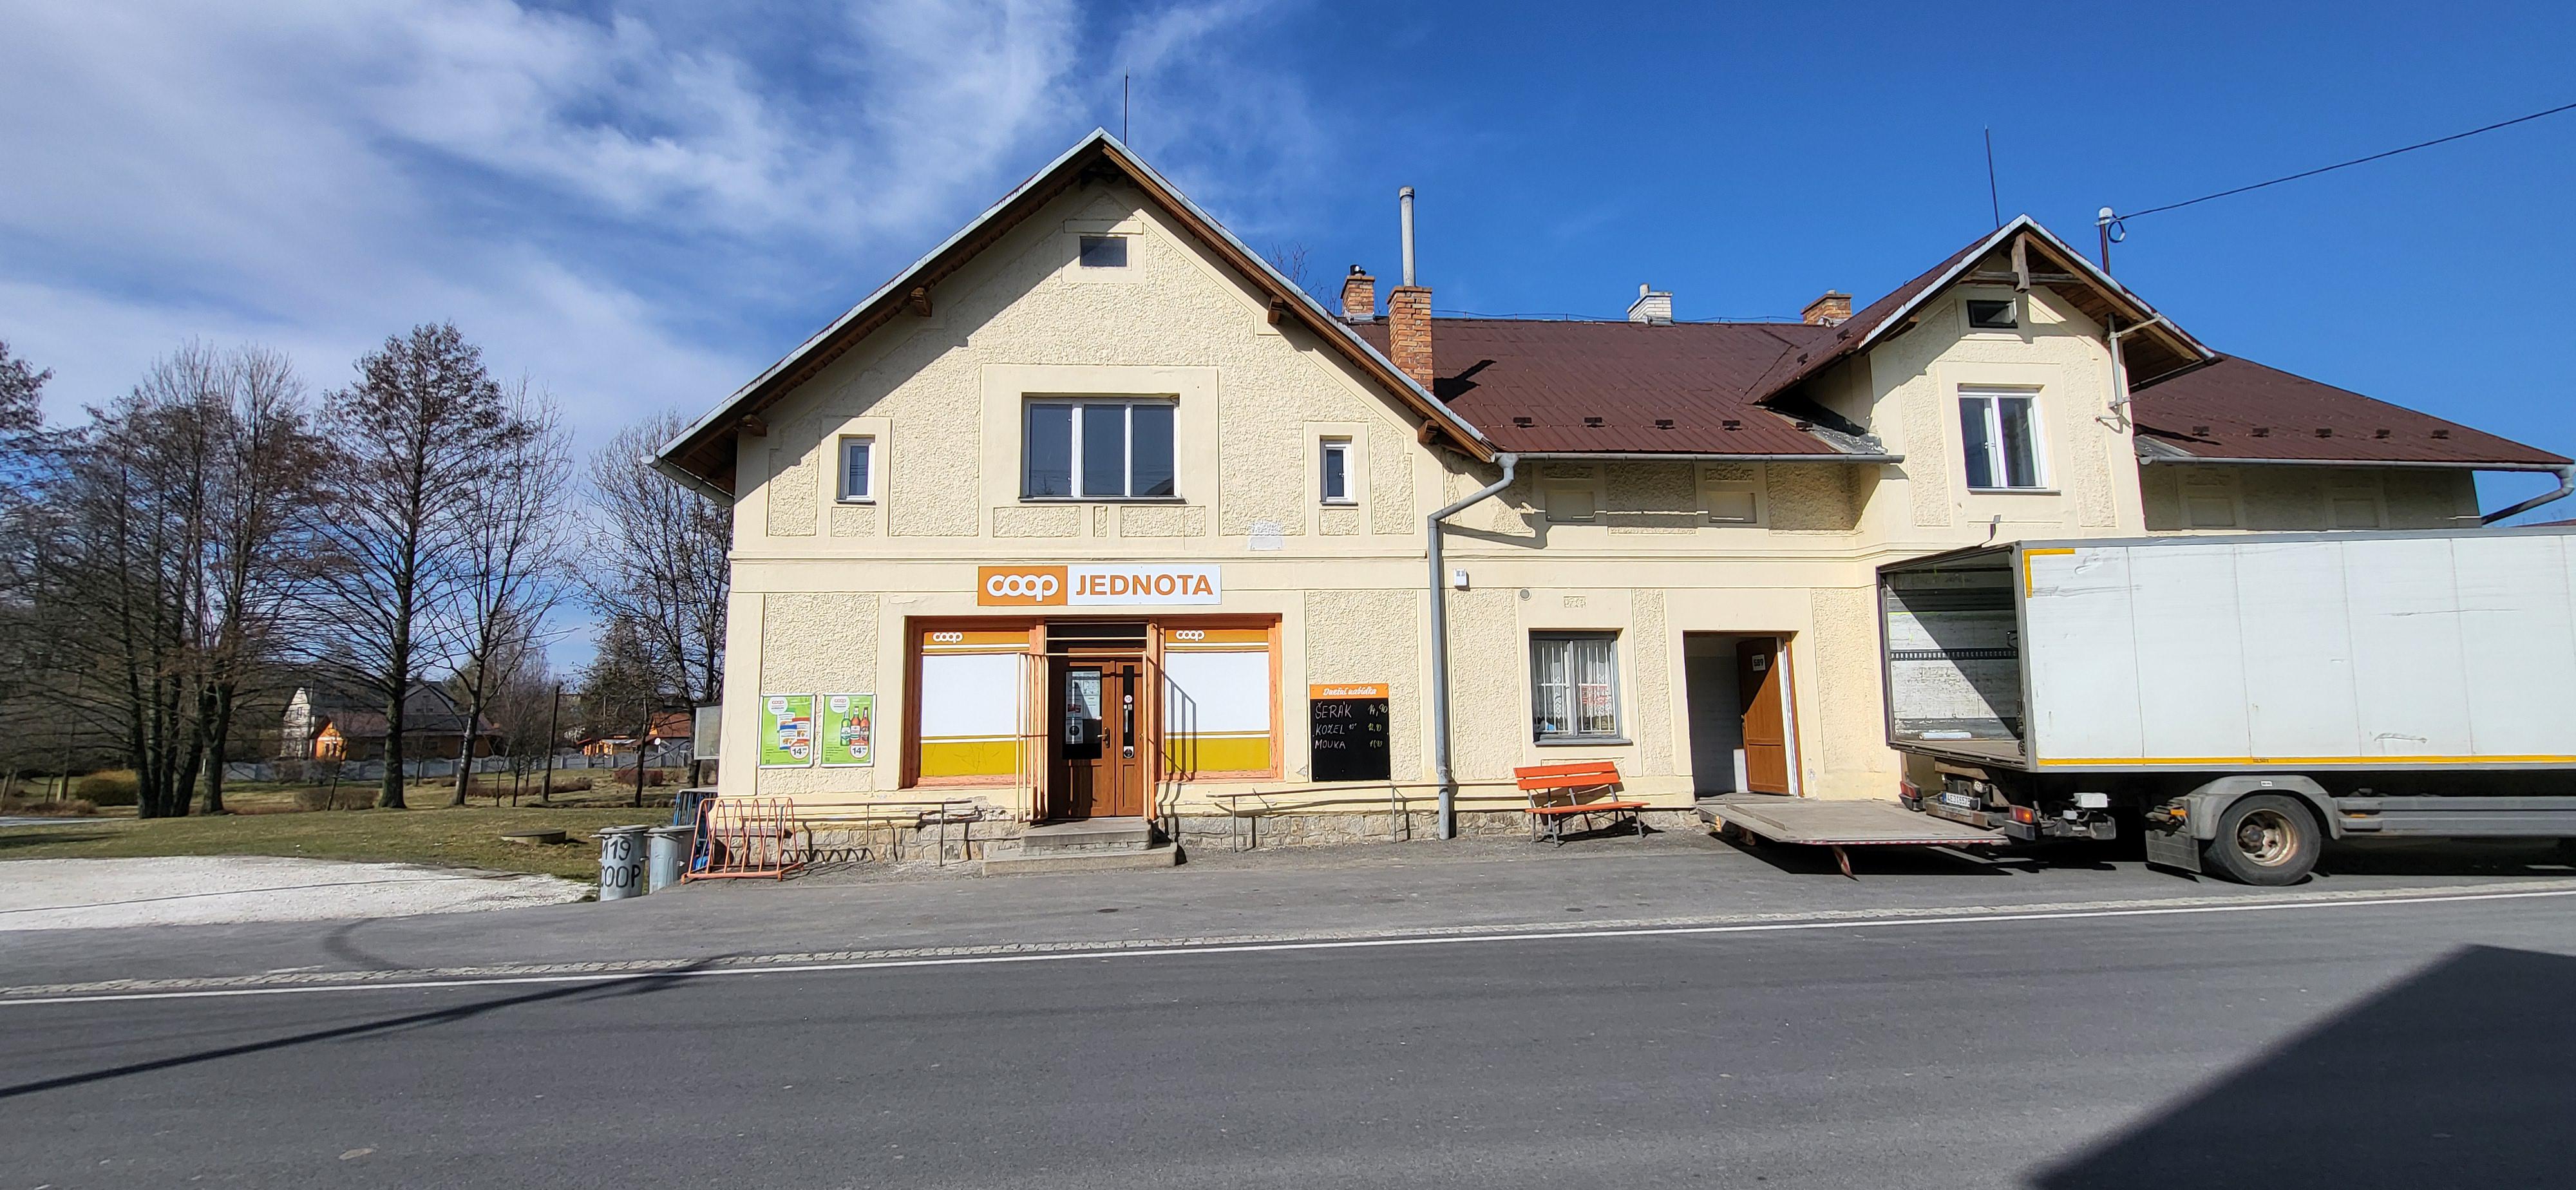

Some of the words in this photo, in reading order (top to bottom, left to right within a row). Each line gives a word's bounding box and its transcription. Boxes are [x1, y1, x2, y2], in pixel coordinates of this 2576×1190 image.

[986, 574, 1059, 602] coop
[1076, 574, 1214, 596] JEDNOTA
[933, 632, 963, 643] coop
[1176, 630, 1205, 641] coop
[1315, 701, 1352, 719] ŠERÁK
[1316, 723, 1345, 735] KOZEL
[1314, 739, 1346, 750] MOUKA
